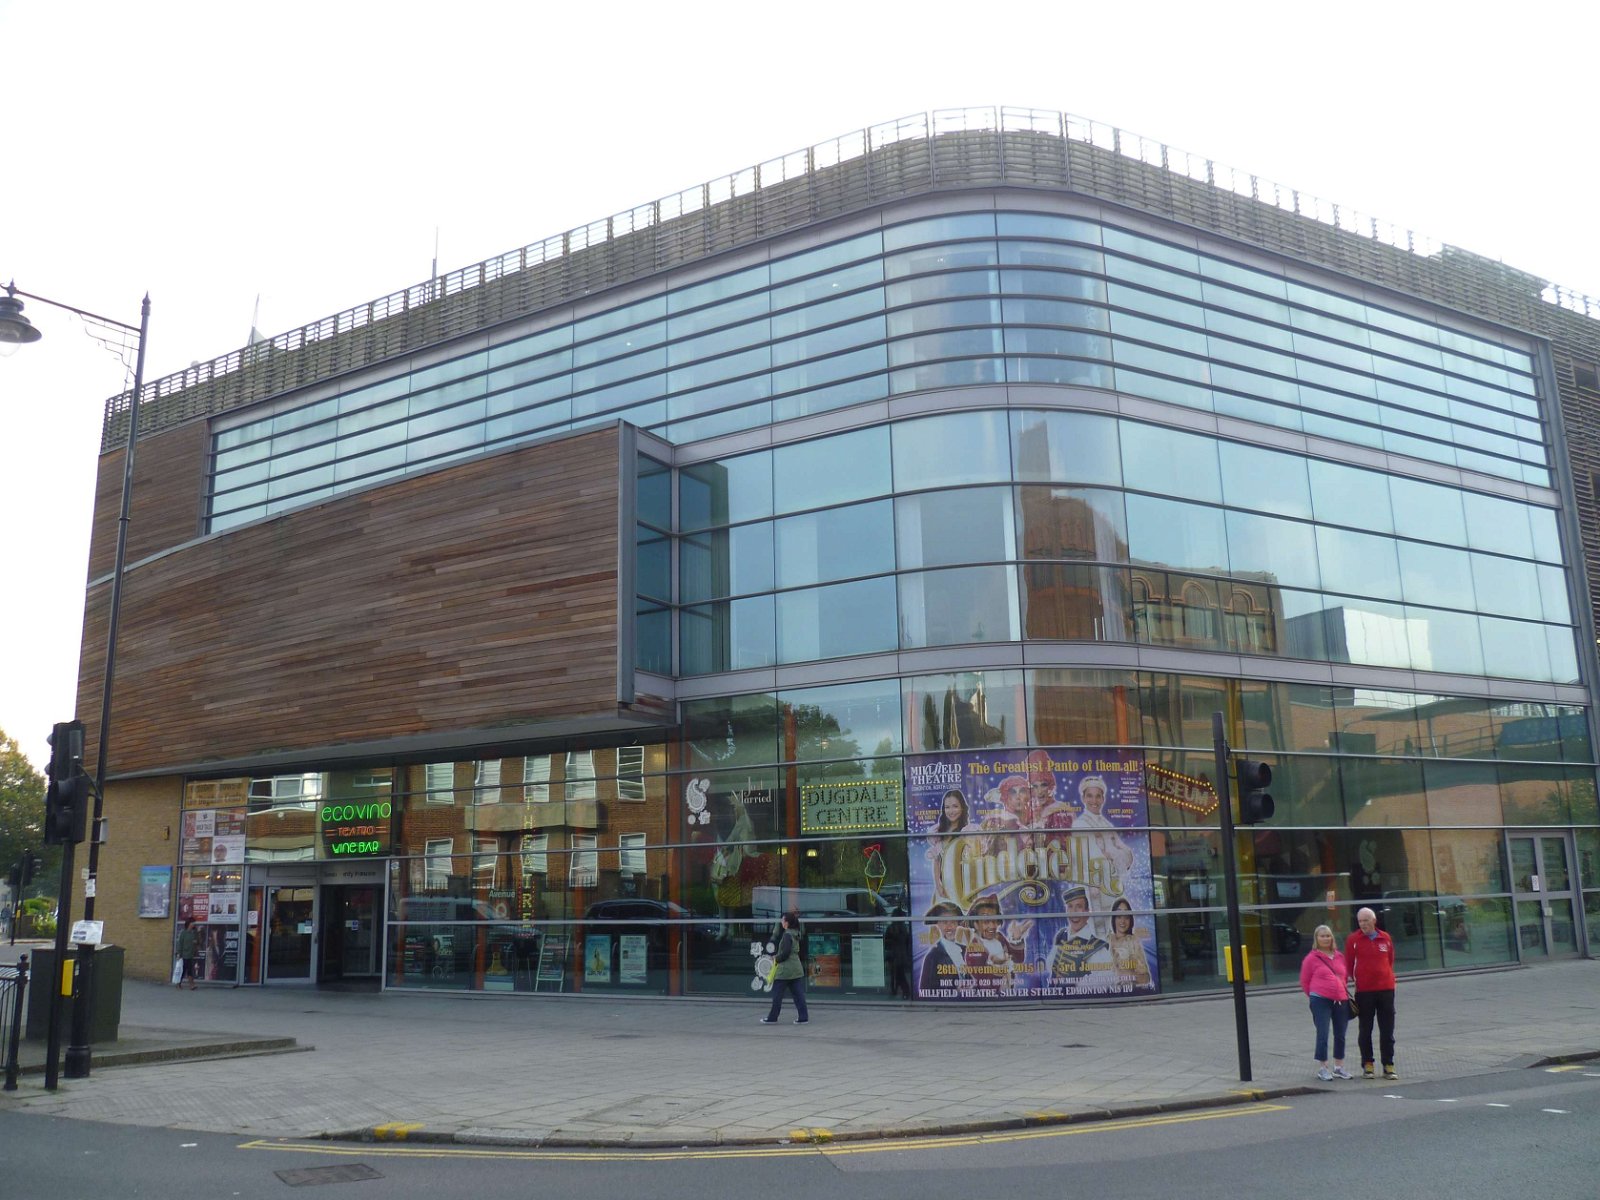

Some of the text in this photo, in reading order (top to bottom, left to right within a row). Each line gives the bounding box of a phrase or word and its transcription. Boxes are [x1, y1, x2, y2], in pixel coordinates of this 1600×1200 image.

[968, 759, 1139, 775] The Greatest Panto of them all!
[911, 773, 962, 785] THEATRE
[731, 789, 772, 805] Married
[807, 785, 896, 807] DUGDALE
[1147, 773, 1209, 807] MUSEUM
[815, 804, 889, 825] CENTRE
[358, 840, 379, 854] BAR
[522, 795, 533, 928] THEATRE
[488, 889, 515, 898] Avenue
[936, 964, 958, 975] 26th
[961, 964, 1008, 975] November
[1012, 963, 1034, 974] 2015
[940, 979, 953, 987] BOX
[918, 988, 958, 998] MILLFIELD
[1000, 987, 1029, 997] SILVER
[1030, 986, 1064, 997] STREET,
[1065, 985, 1108, 996] EDMONTON
